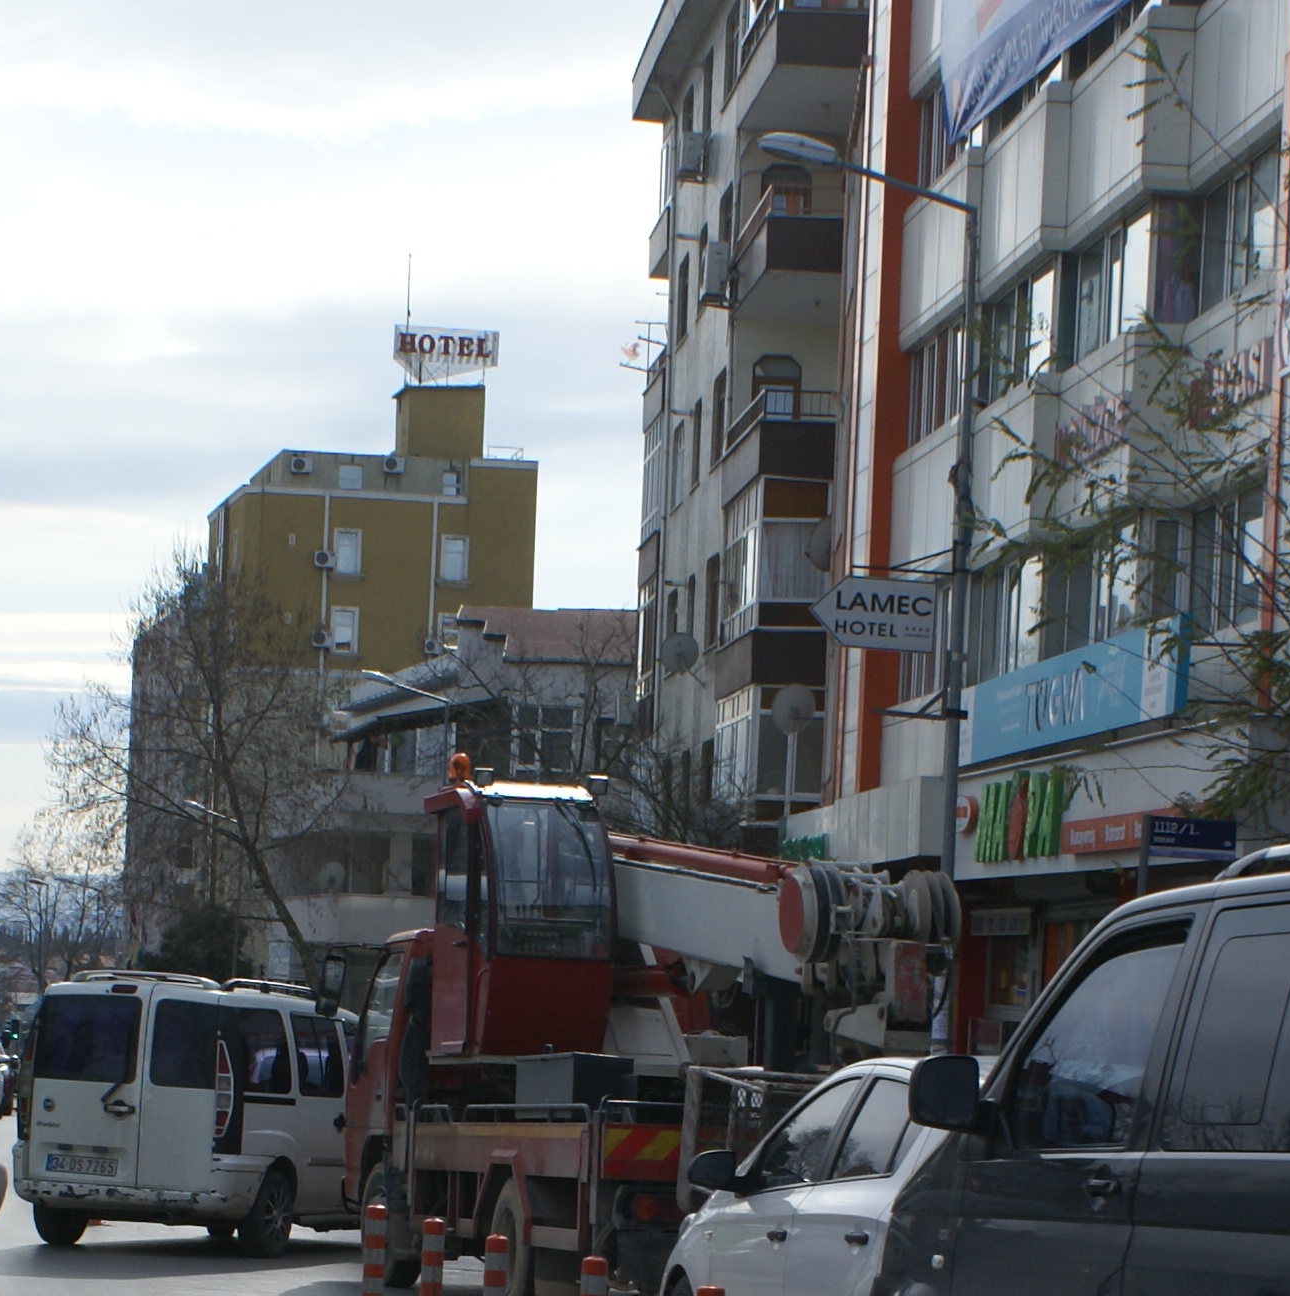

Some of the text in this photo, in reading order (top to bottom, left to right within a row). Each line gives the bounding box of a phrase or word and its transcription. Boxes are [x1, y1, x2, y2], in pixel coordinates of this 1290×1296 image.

[399, 332, 493, 359] HOTEL
[835, 590, 933, 617] LAMEC
[834, 618, 898, 639] HOTEL
[51, 1156, 67, 1169] 34
